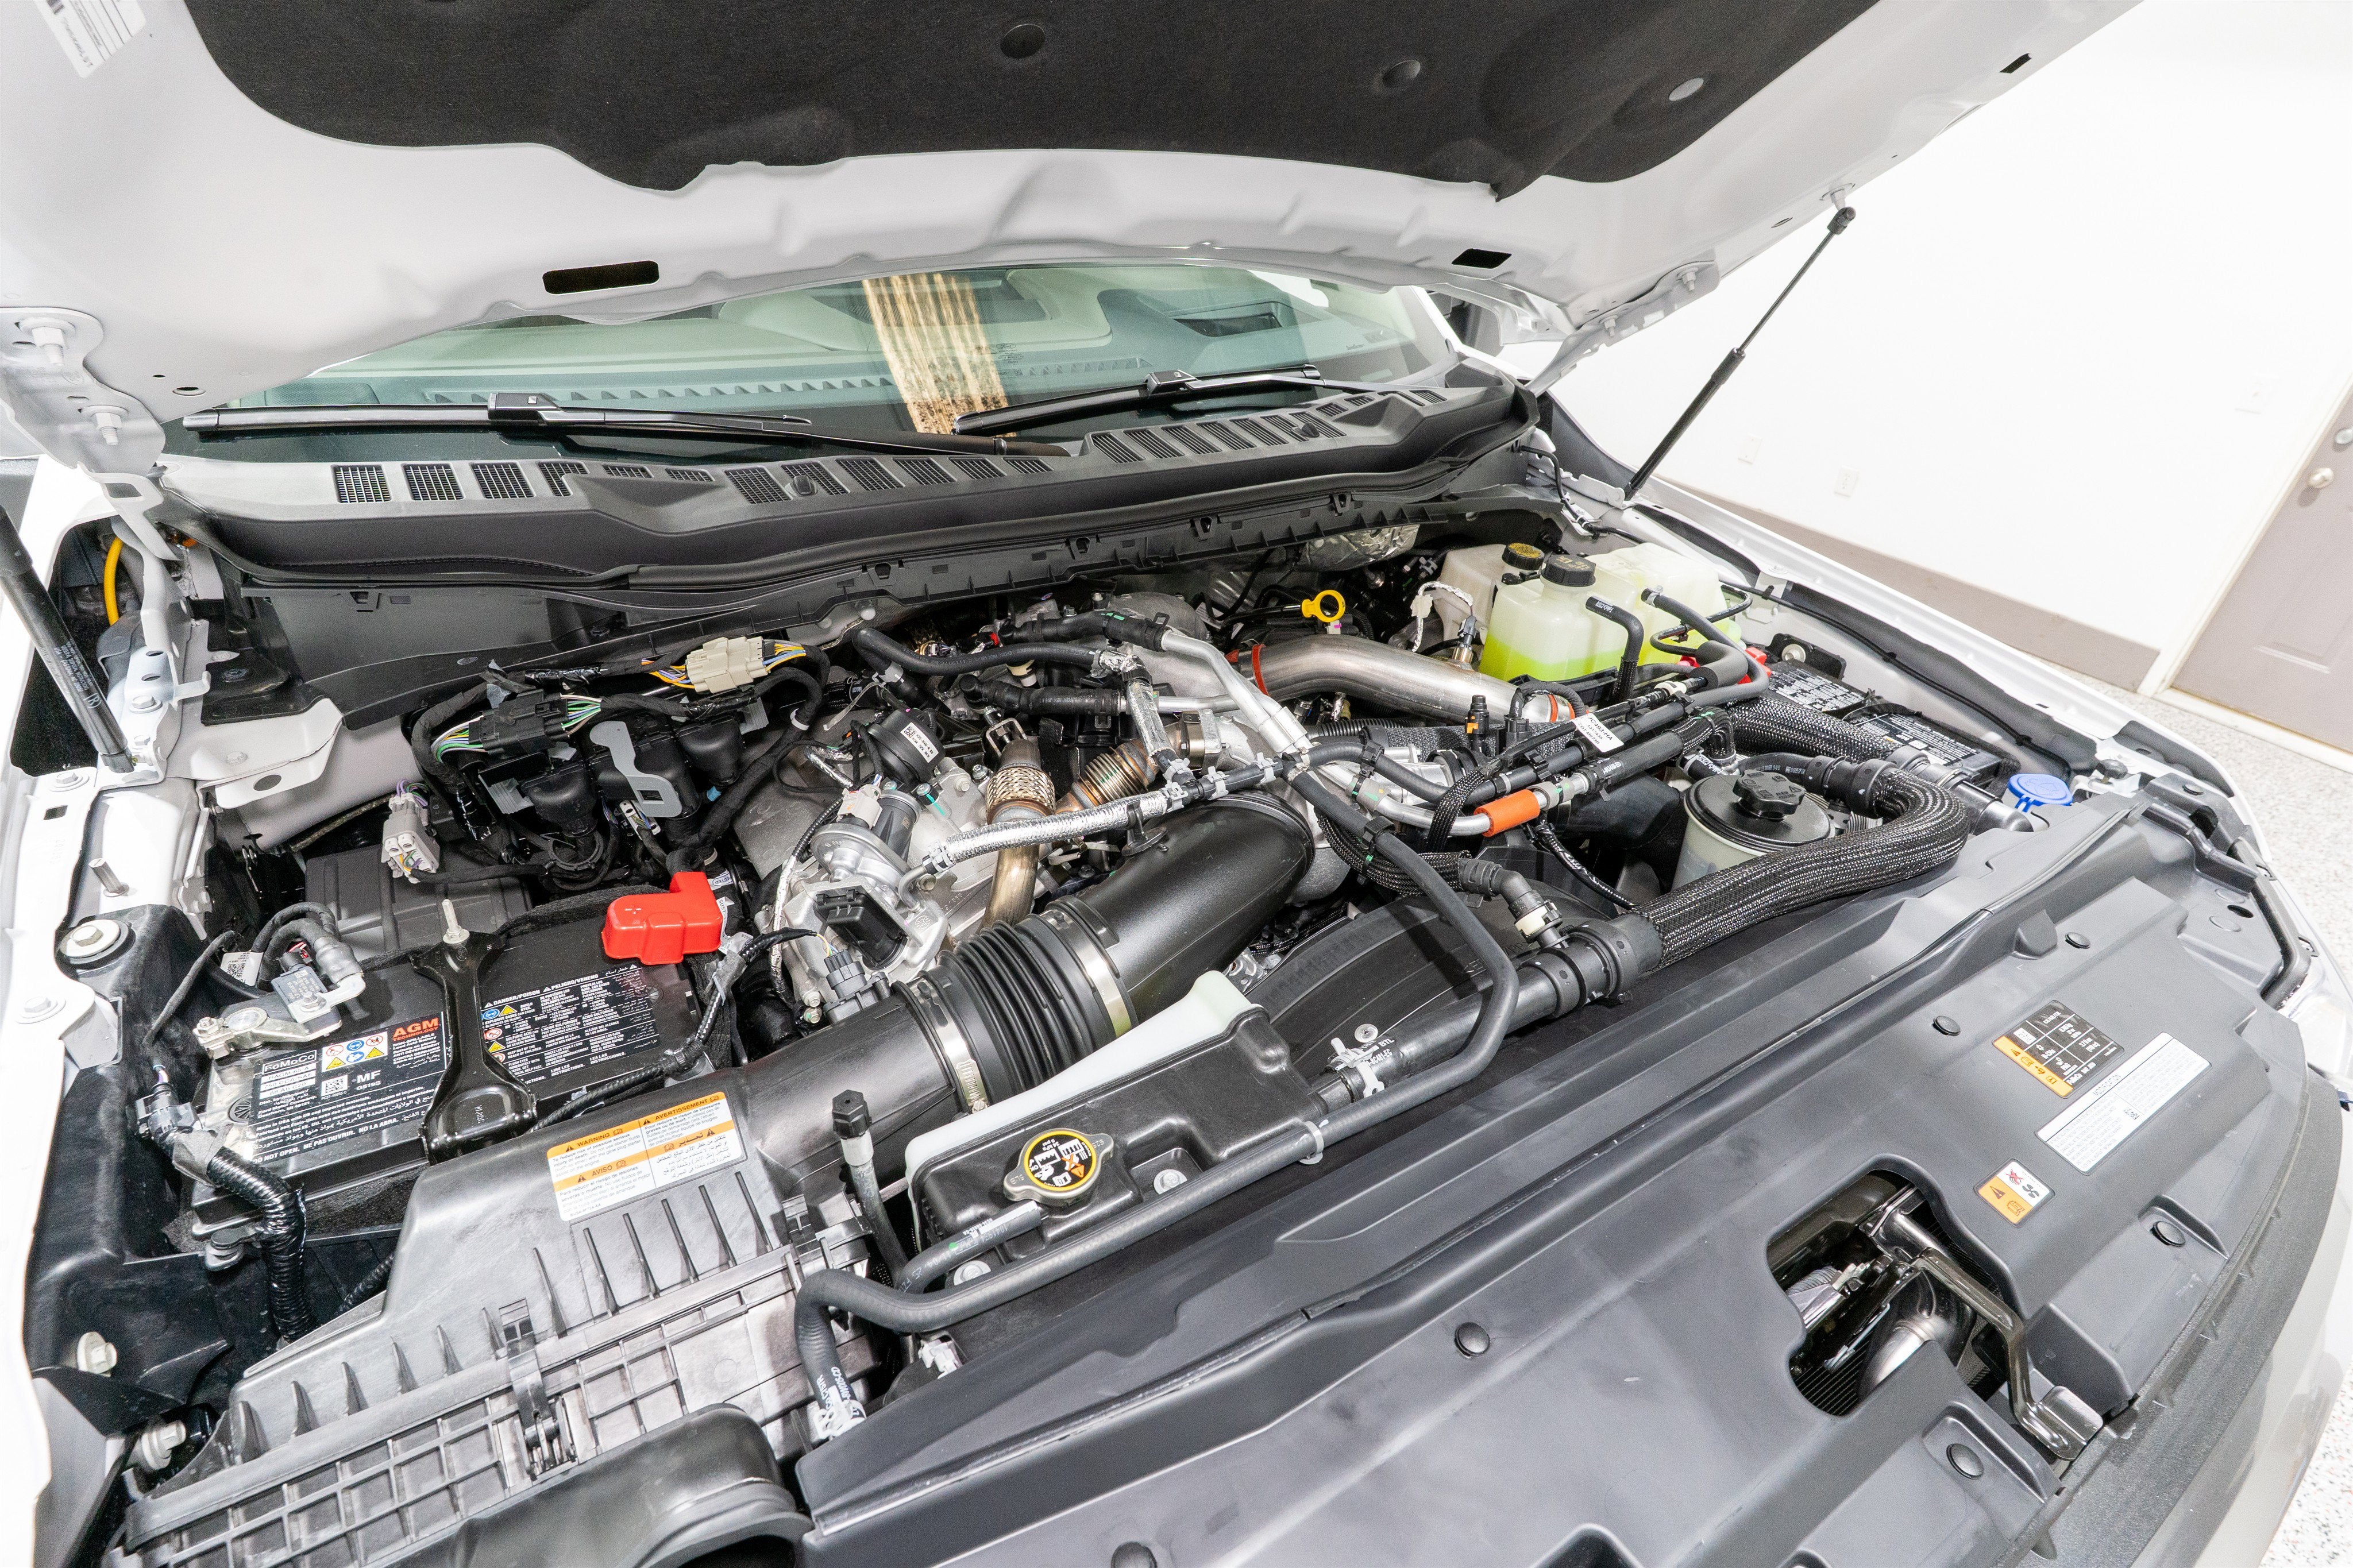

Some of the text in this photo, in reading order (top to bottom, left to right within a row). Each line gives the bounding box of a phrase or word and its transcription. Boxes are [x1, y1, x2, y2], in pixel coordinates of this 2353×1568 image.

[551, 974, 598, 989] PELIGRO/VENENO
[493, 990, 540, 1005] DANGER/POISON
[392, 1017, 439, 1038] AGM
[392, 1026, 439, 1041] TECHNOLOGY
[1378, 1038, 1395, 1046] BTL
[264, 1054, 315, 1072] FoMoCo
[590, 1052, 626, 1064] INSTRUCCIONES.
[357, 1070, 381, 1083] MF
[551, 1063, 585, 1077] INSTRUCTIONS.
[356, 1080, 381, 1090] G519S
[272, 1103, 288, 1111] Motor
[289, 1095, 317, 1106] Company,
[322, 1102, 345, 1112] imported
[655, 1098, 708, 1120] AVERTISSEMENT
[655, 1118, 673, 1126] réduire
[678, 1111, 693, 1119] risque
[698, 1101, 721, 1111] blessures
[645, 1126, 662, 1135] graves
[264, 1153, 279, 1161] NOT
[279, 1146, 300, 1156] OPEN.
[314, 1138, 327, 1147] PAS
[328, 1130, 356, 1142] OUVRIR.
[379, 1118, 399, 1127] ABRA.
[560, 1152, 577, 1160] reduce
[592, 1139, 612, 1149] possible
[612, 1133, 630, 1142] serious
[577, 1132, 611, 1148] WARNING
[553, 1160, 568, 1168] injury
[591, 1164, 614, 1177] AVISO
[572, 1184, 589, 1193] reducir
[596, 1176, 611, 1184] riesgo
[618, 1165, 638, 1175] lesiones
